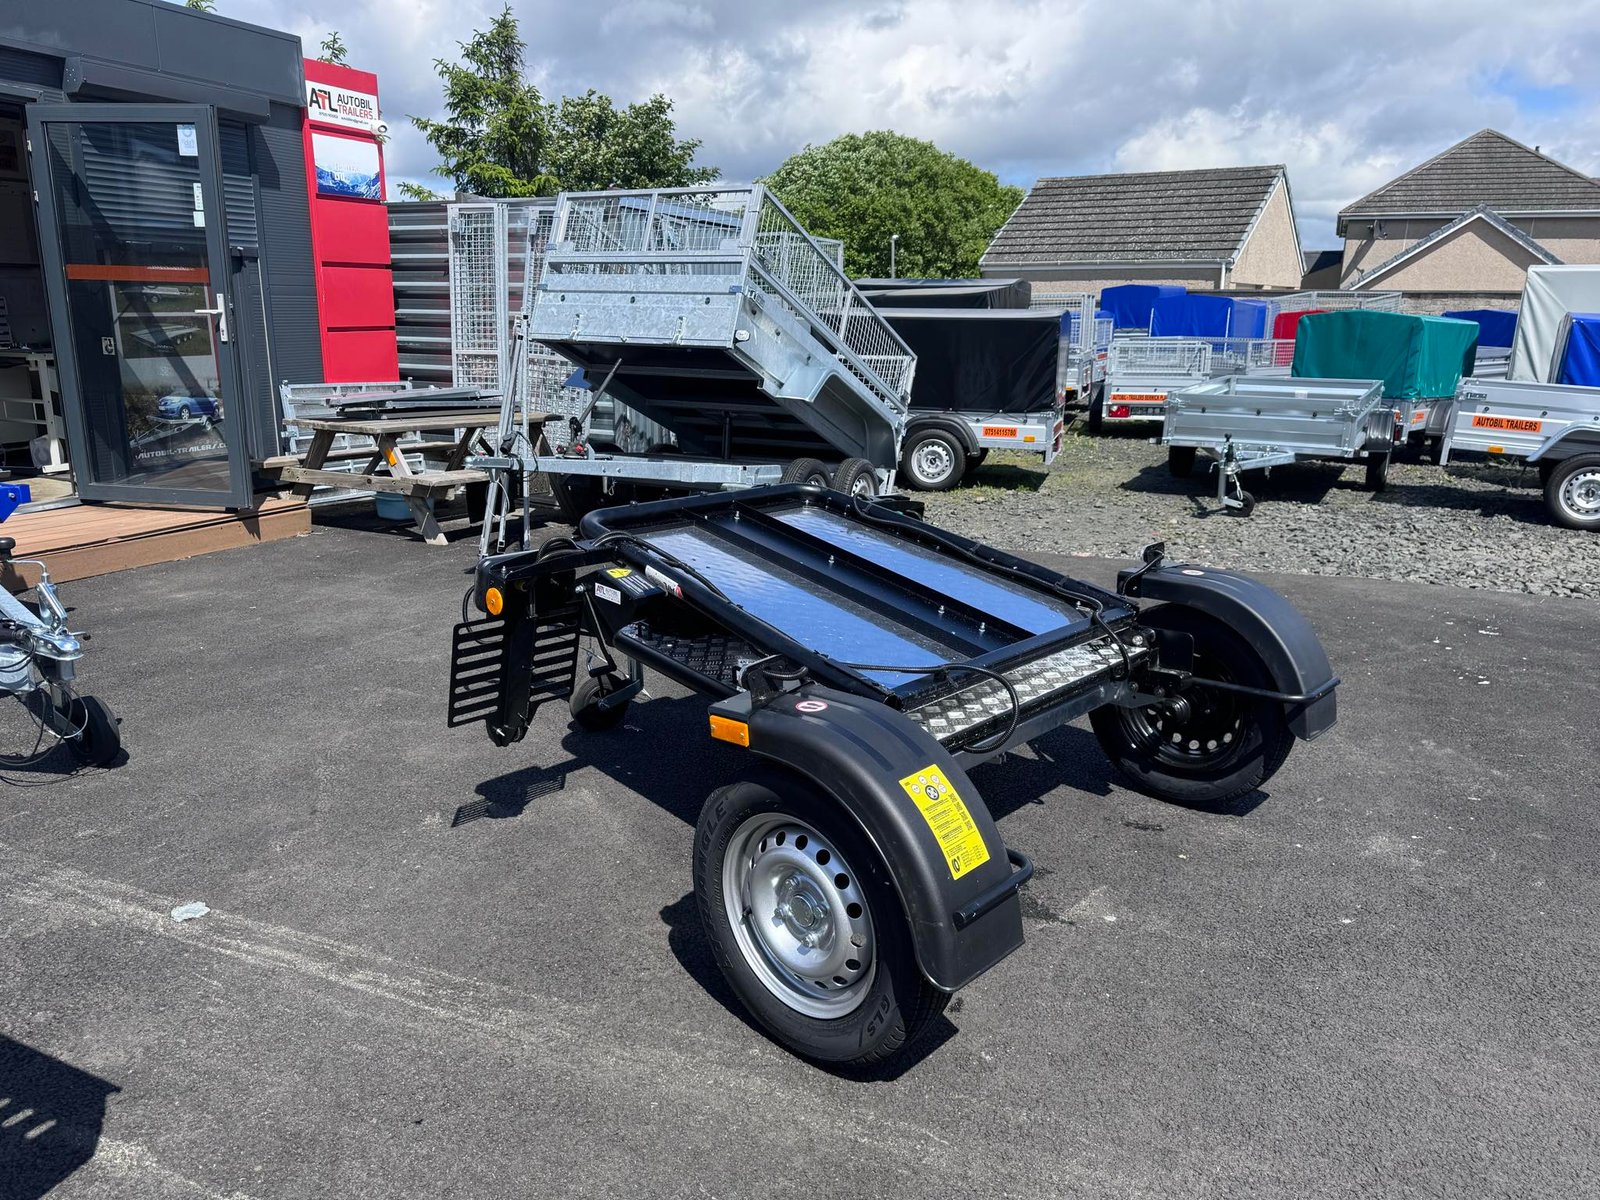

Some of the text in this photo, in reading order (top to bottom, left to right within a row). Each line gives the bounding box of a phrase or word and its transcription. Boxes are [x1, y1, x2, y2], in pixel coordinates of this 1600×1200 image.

[309, 87, 338, 113] ATL
[337, 93, 373, 111] AUTOBIL
[337, 103, 374, 120] TRAILERS
[1476, 417, 1538, 431] AUTOBIL TRAILERS
